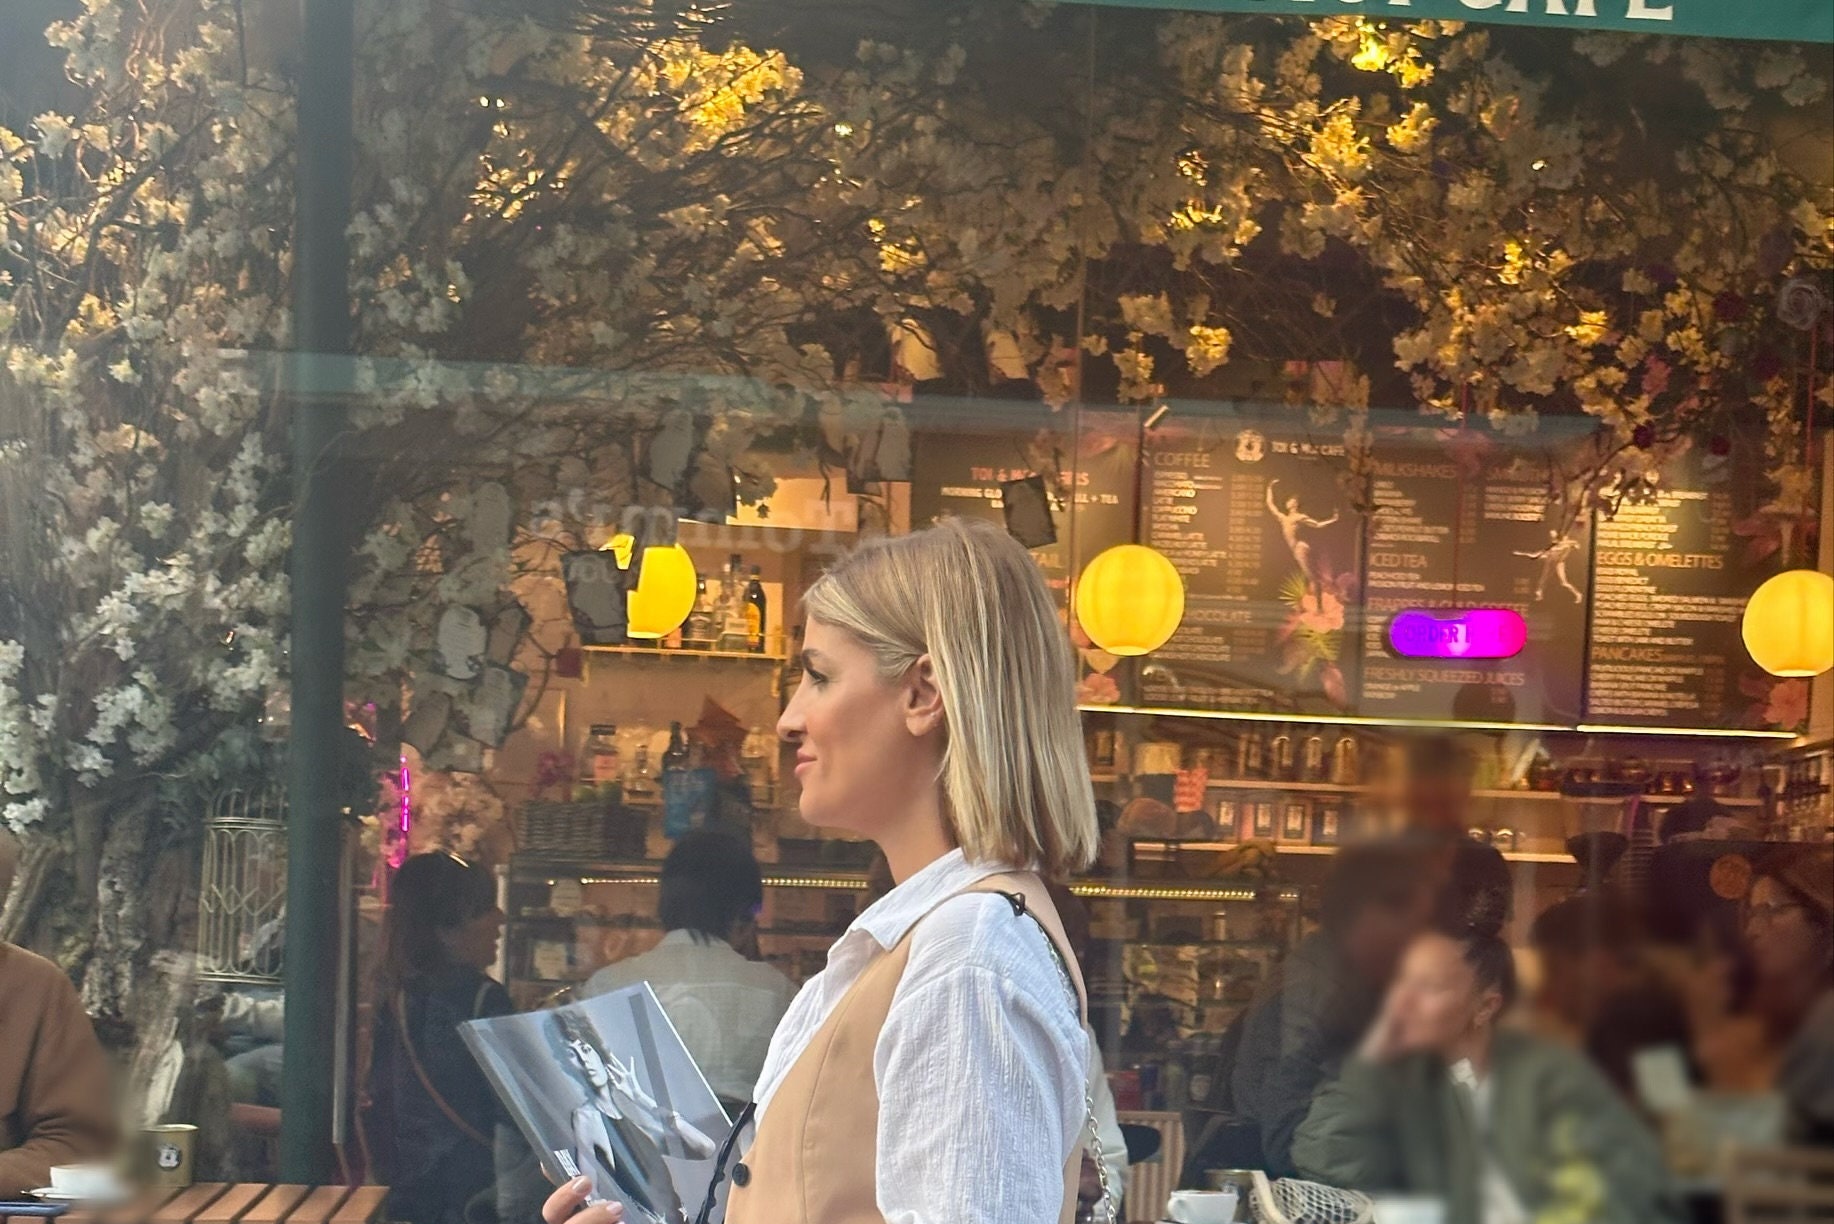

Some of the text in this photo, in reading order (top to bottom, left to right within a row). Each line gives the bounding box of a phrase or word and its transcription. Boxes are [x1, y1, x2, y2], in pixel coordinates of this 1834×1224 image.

[1153, 452, 1210, 468] COFFEE
[1370, 552, 1428, 568] ICED TEA
[1596, 551, 1723, 568] EGGS & OMELETTES
